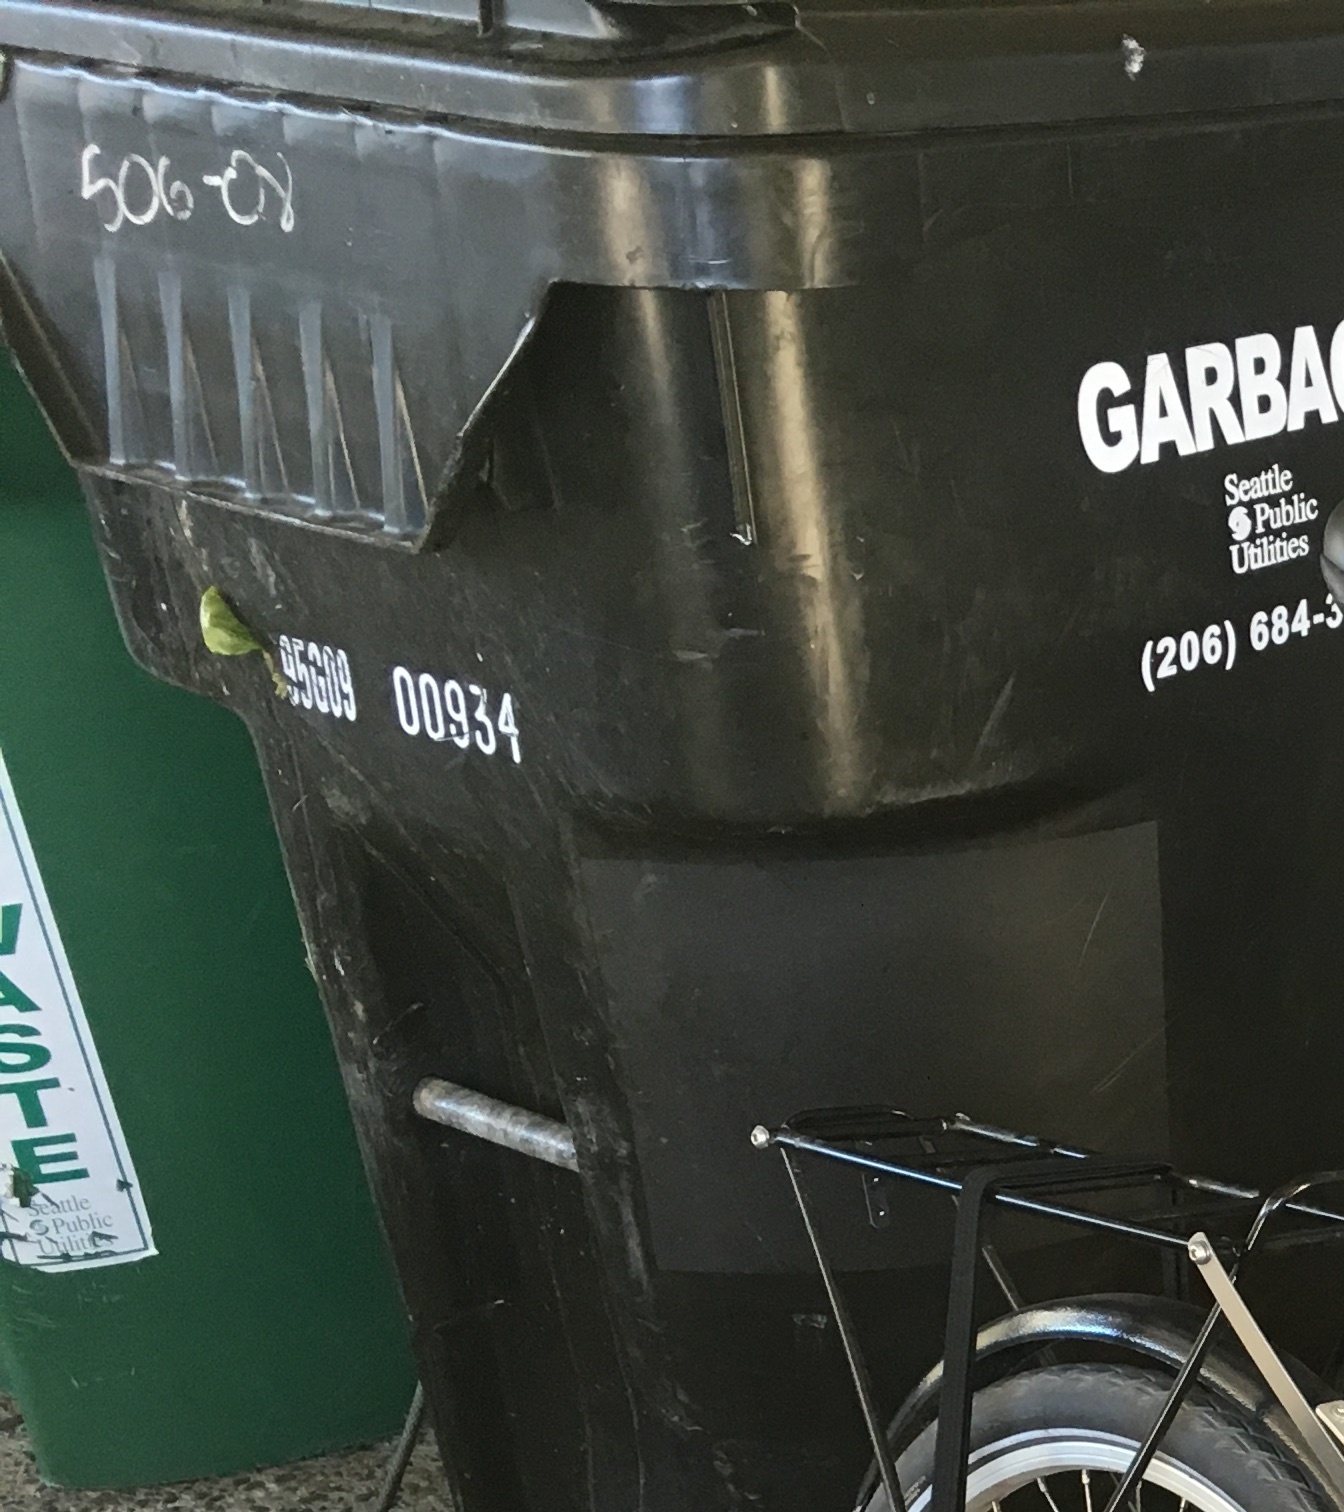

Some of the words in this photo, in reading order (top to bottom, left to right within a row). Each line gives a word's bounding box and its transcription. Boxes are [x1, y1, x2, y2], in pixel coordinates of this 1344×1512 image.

[1224, 463, 1293, 505] Seattle
[1253, 493, 1319, 533] Public
[1229, 532, 1309, 574] Utilities
[1141, 619, 1236, 692] (206)
[392, 665, 521, 764] 00934
[0, 903, 90, 1185] ASTE
[28, 1195, 91, 1217] Seattle
[52, 1212, 114, 1234] Public
